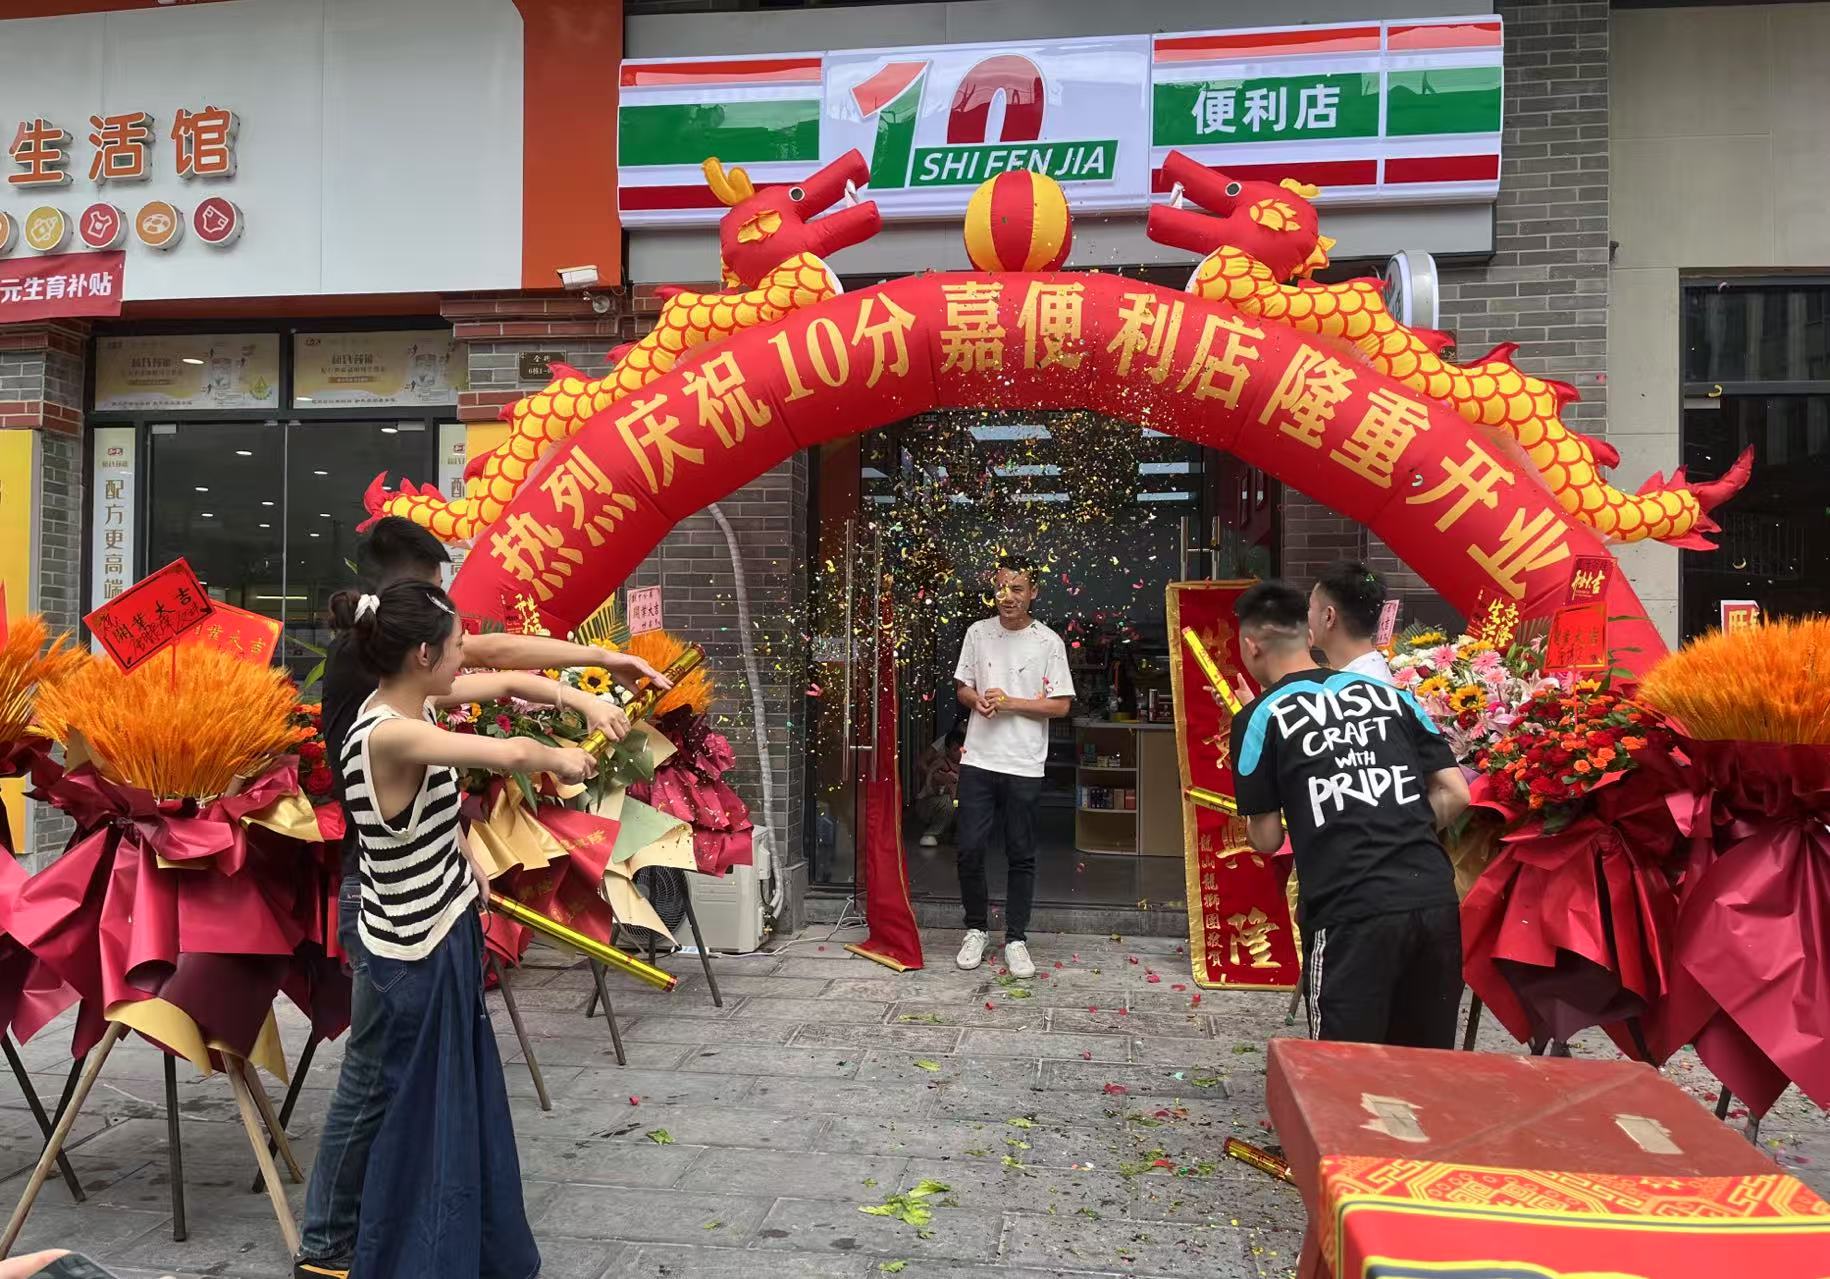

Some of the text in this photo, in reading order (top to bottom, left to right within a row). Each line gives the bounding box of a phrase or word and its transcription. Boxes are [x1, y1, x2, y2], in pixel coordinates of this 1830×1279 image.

[850, 54, 1045, 190] 10
[1191, 83, 1341, 135] 便利店
[8, 105, 234, 186] 生活馆
[919, 151, 980, 181] SHI
[1054, 146, 1105, 177] JIA
[0, 271, 113, 304] 元生育补贴
[490, 280, 1572, 600] 热烈庆祝10分嘉便利店隆重开业
[104, 479, 124, 600] 配方更高端
[1267, 684, 1403, 740] EVISU
[1302, 716, 1392, 757] CRAFT
[1308, 764, 1421, 828] PRIDE
